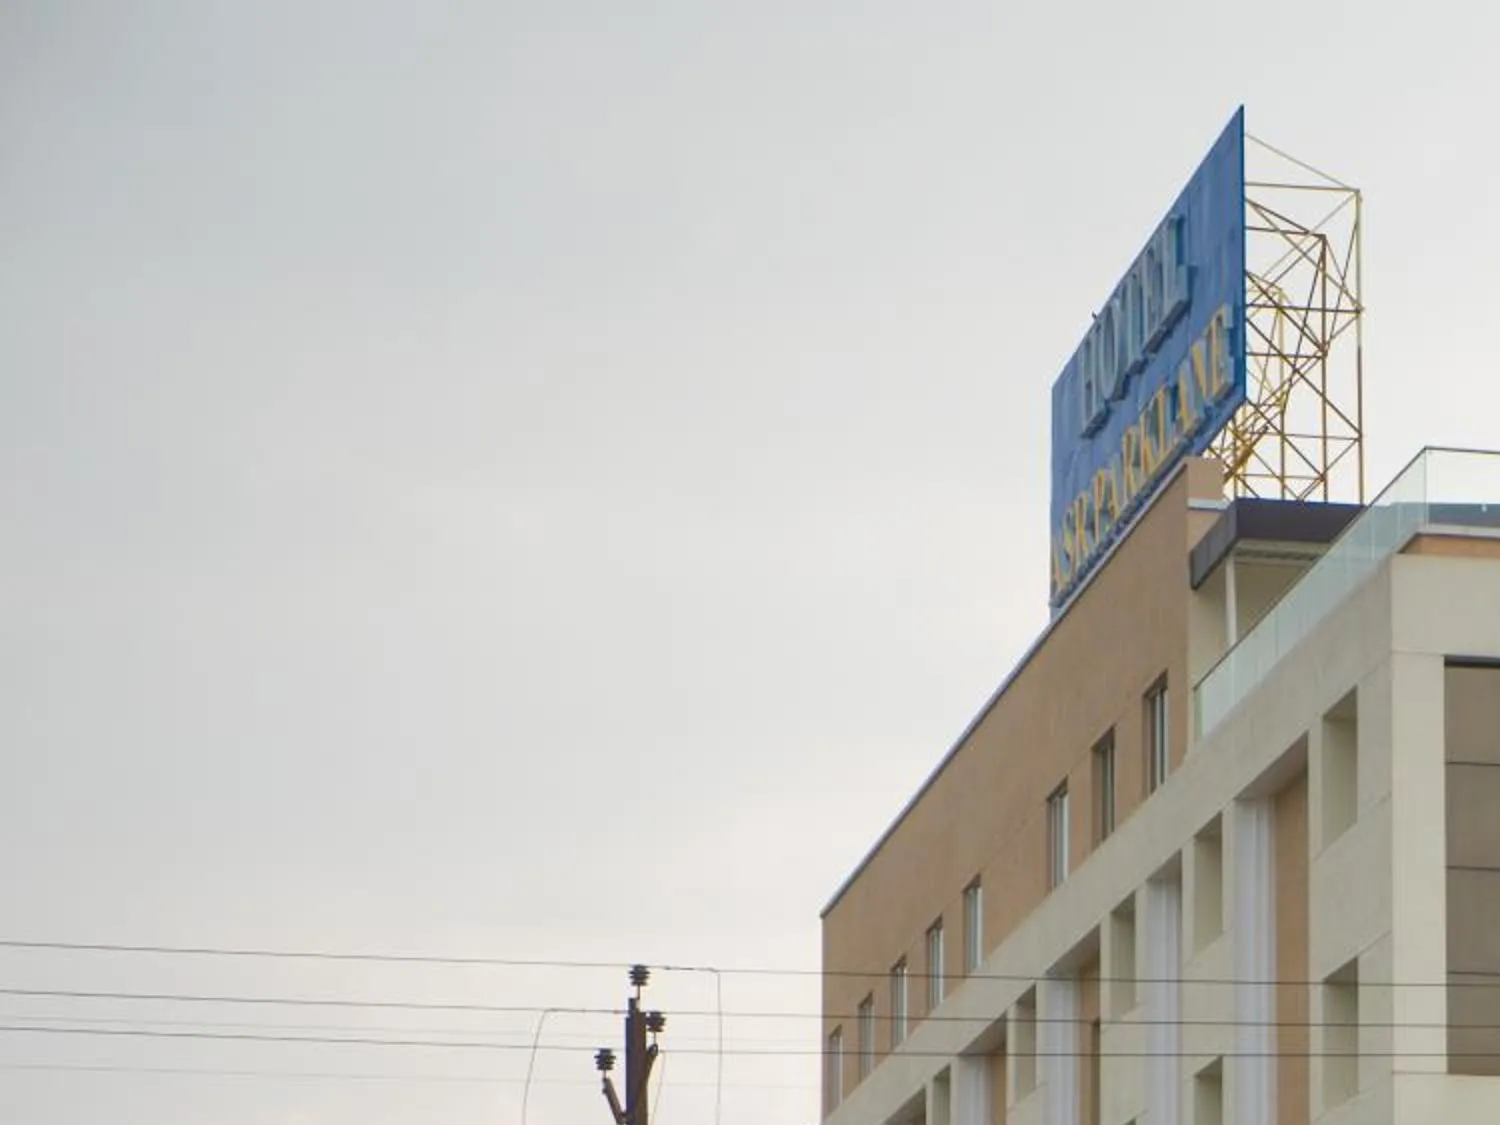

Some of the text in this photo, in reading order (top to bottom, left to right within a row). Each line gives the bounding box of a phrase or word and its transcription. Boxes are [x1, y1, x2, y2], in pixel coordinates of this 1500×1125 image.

[1077, 214, 1190, 426] HOTEL
[1050, 302, 1235, 594] ASR PARKLANE
